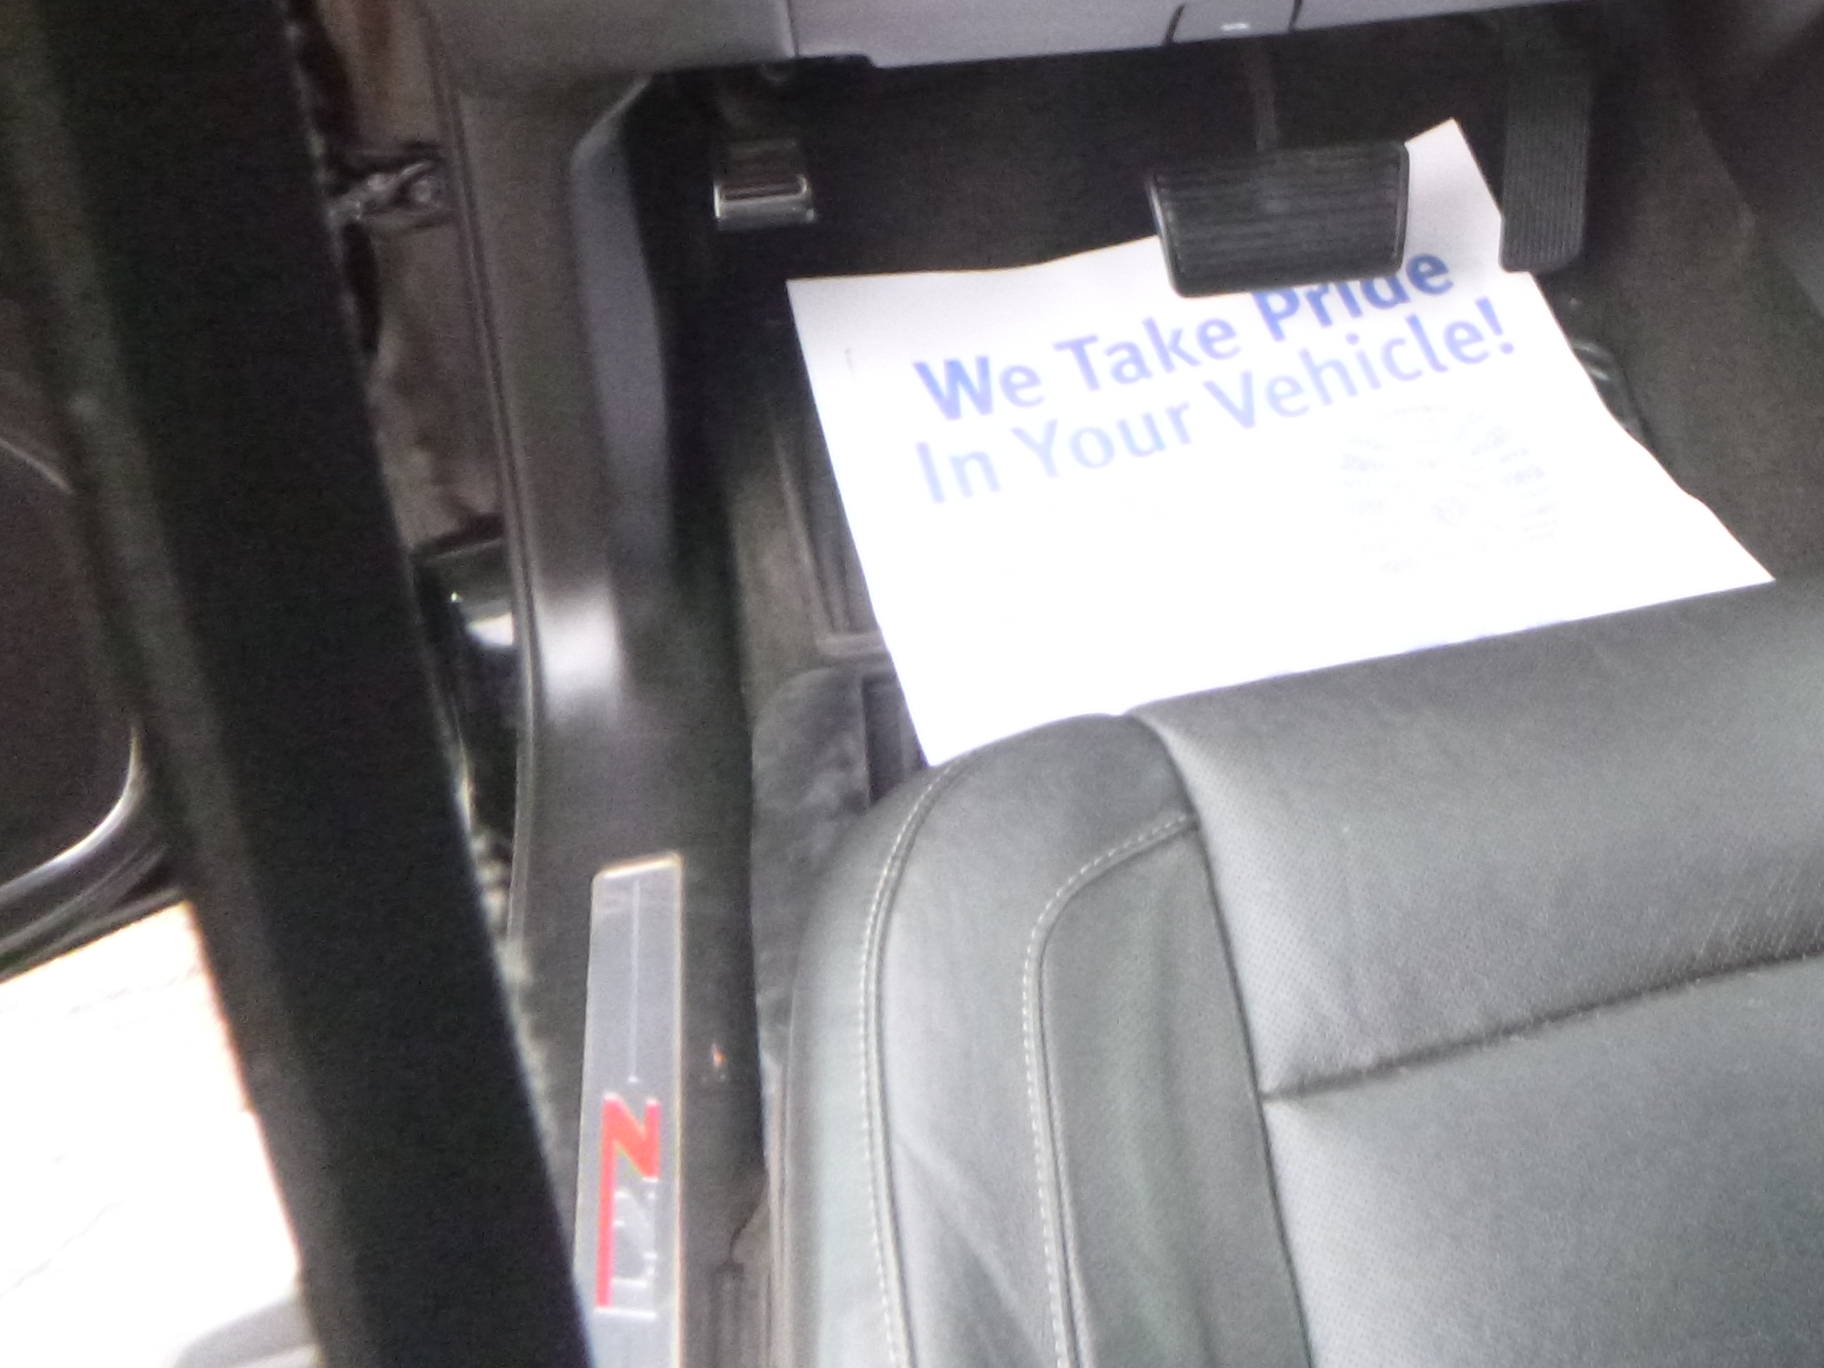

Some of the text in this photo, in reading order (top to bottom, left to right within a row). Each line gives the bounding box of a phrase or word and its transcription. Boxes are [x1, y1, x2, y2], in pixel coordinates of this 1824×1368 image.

[912, 354, 1047, 422] We
[1055, 317, 1242, 394] Take
[914, 296, 1515, 505] In Your Vehicle!
